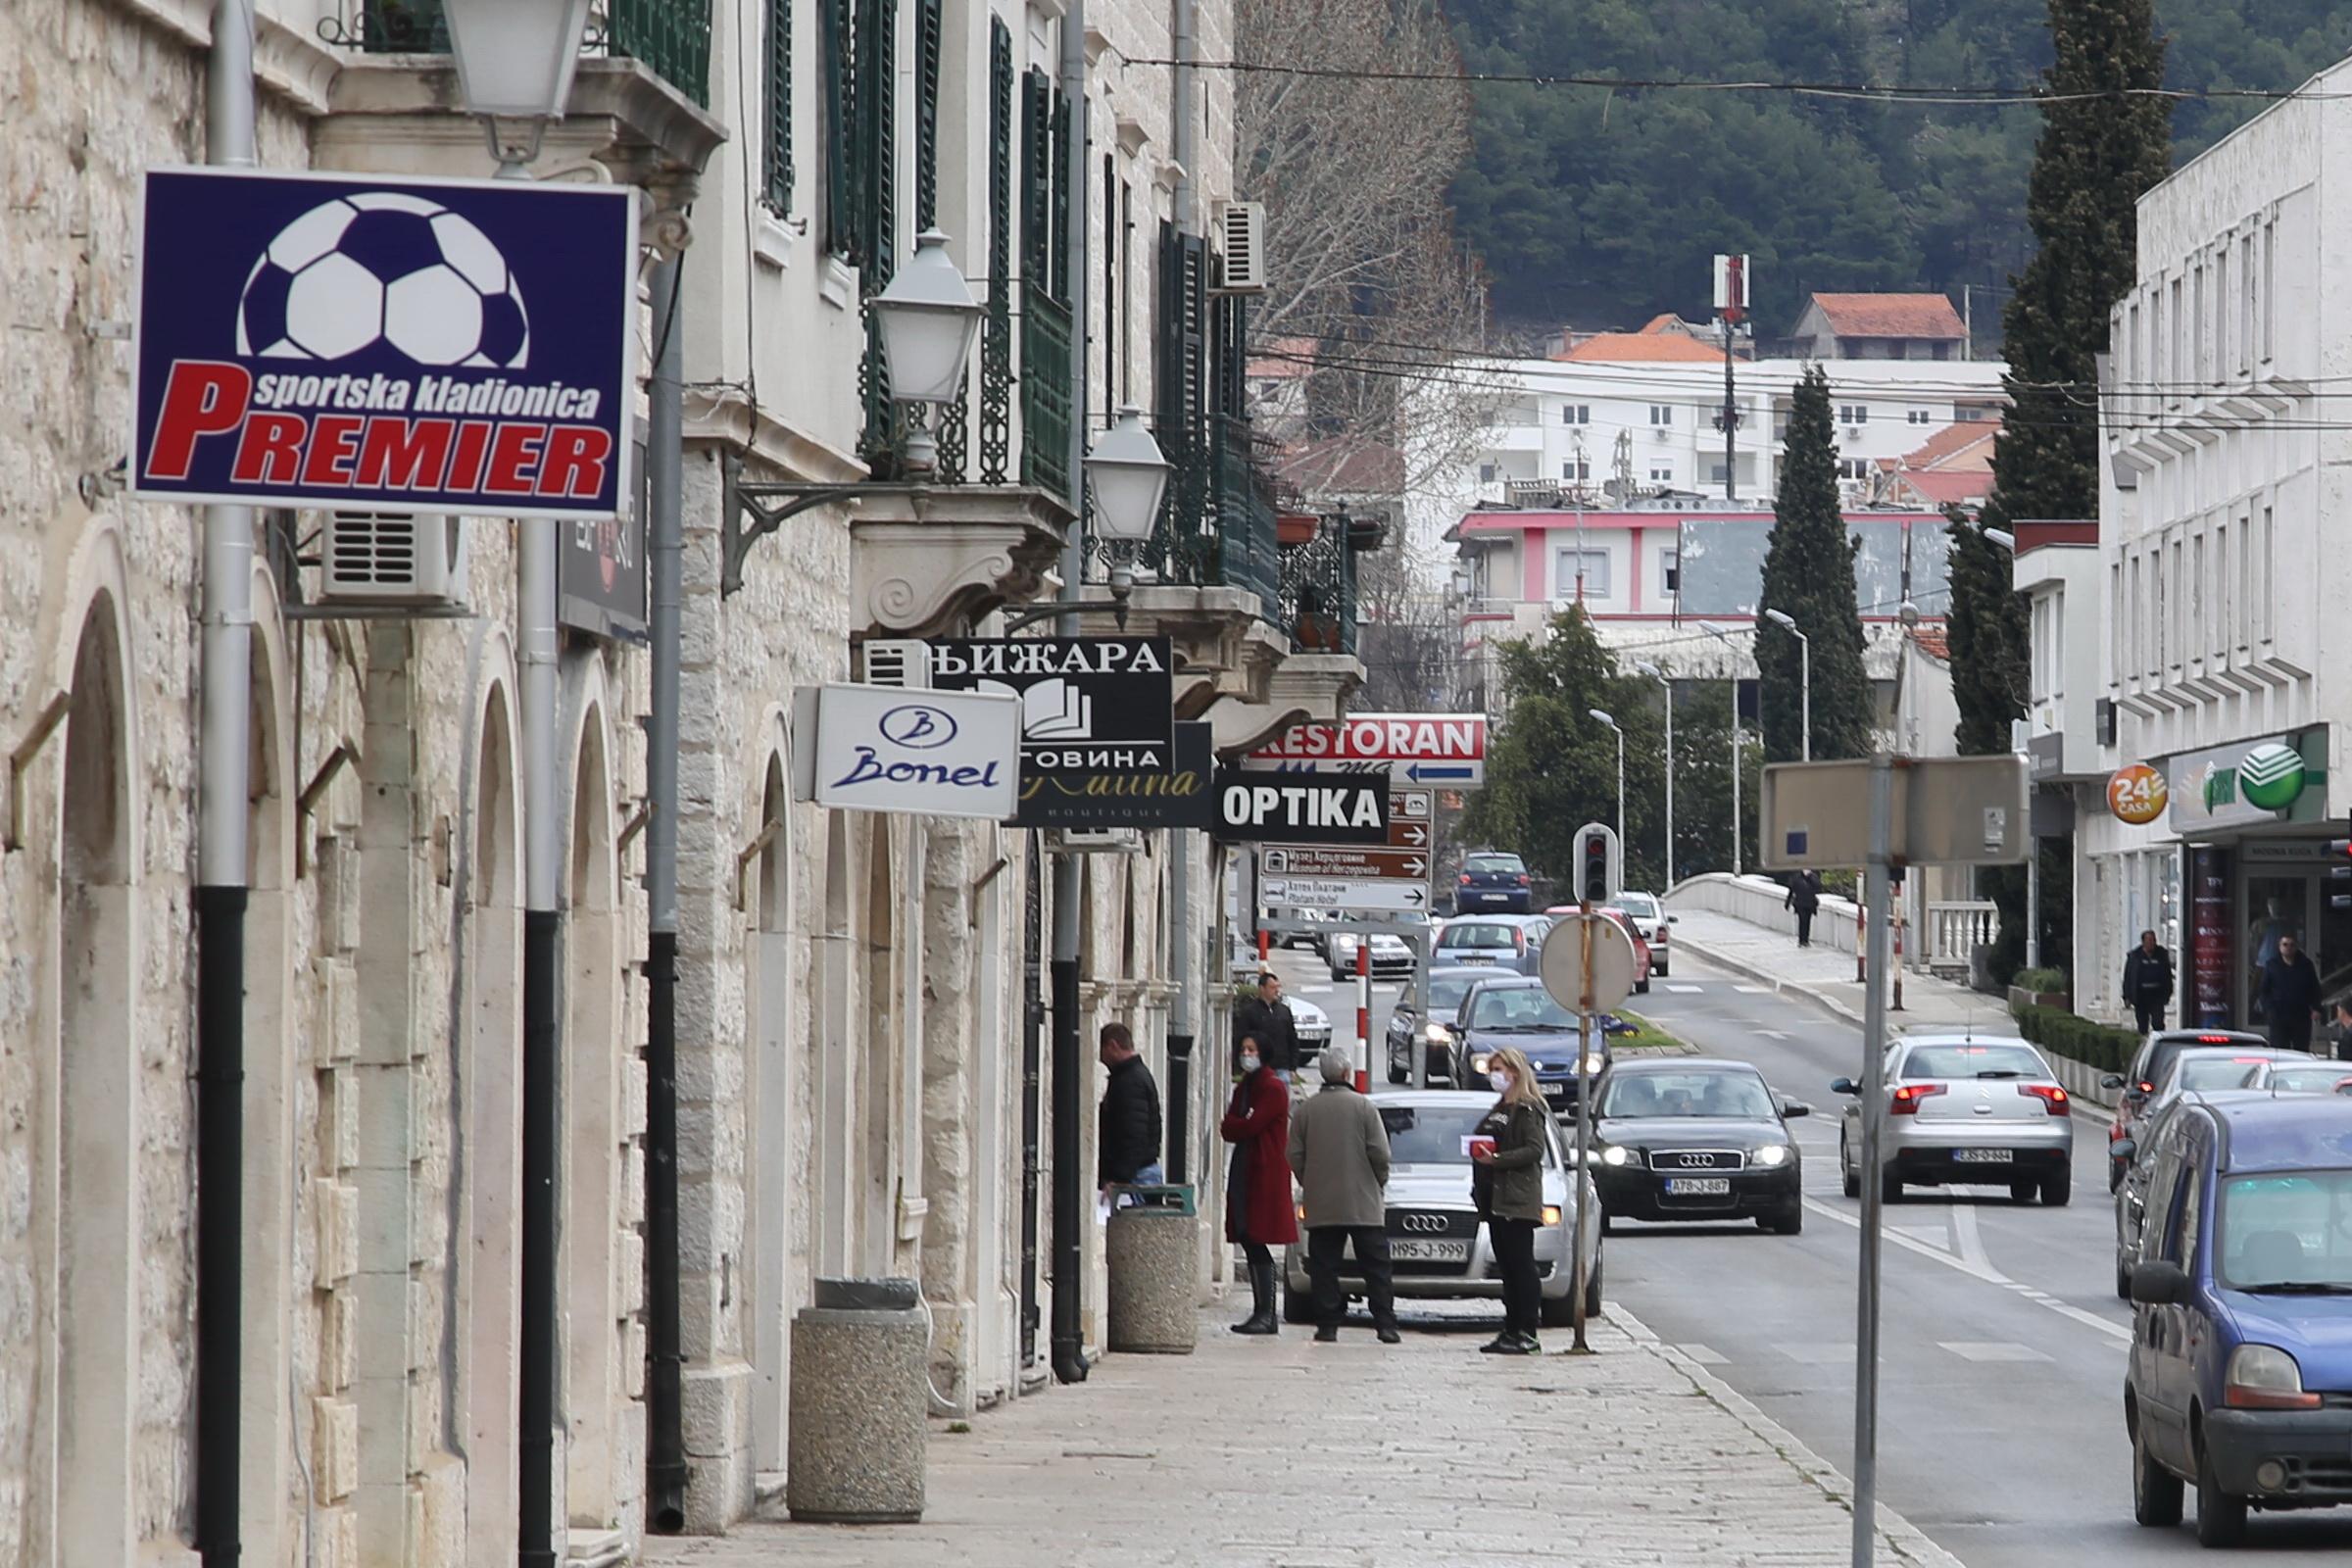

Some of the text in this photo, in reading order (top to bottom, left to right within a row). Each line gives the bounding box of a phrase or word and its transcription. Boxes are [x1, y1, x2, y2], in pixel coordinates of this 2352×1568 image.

[254, 373, 601, 419] sportska kladionica
[144, 359, 612, 501] PREMIER
[830, 746, 1001, 790] Bonel
[2115, 776, 2149, 802] 24
[1223, 786, 1382, 828] OPTIKA
